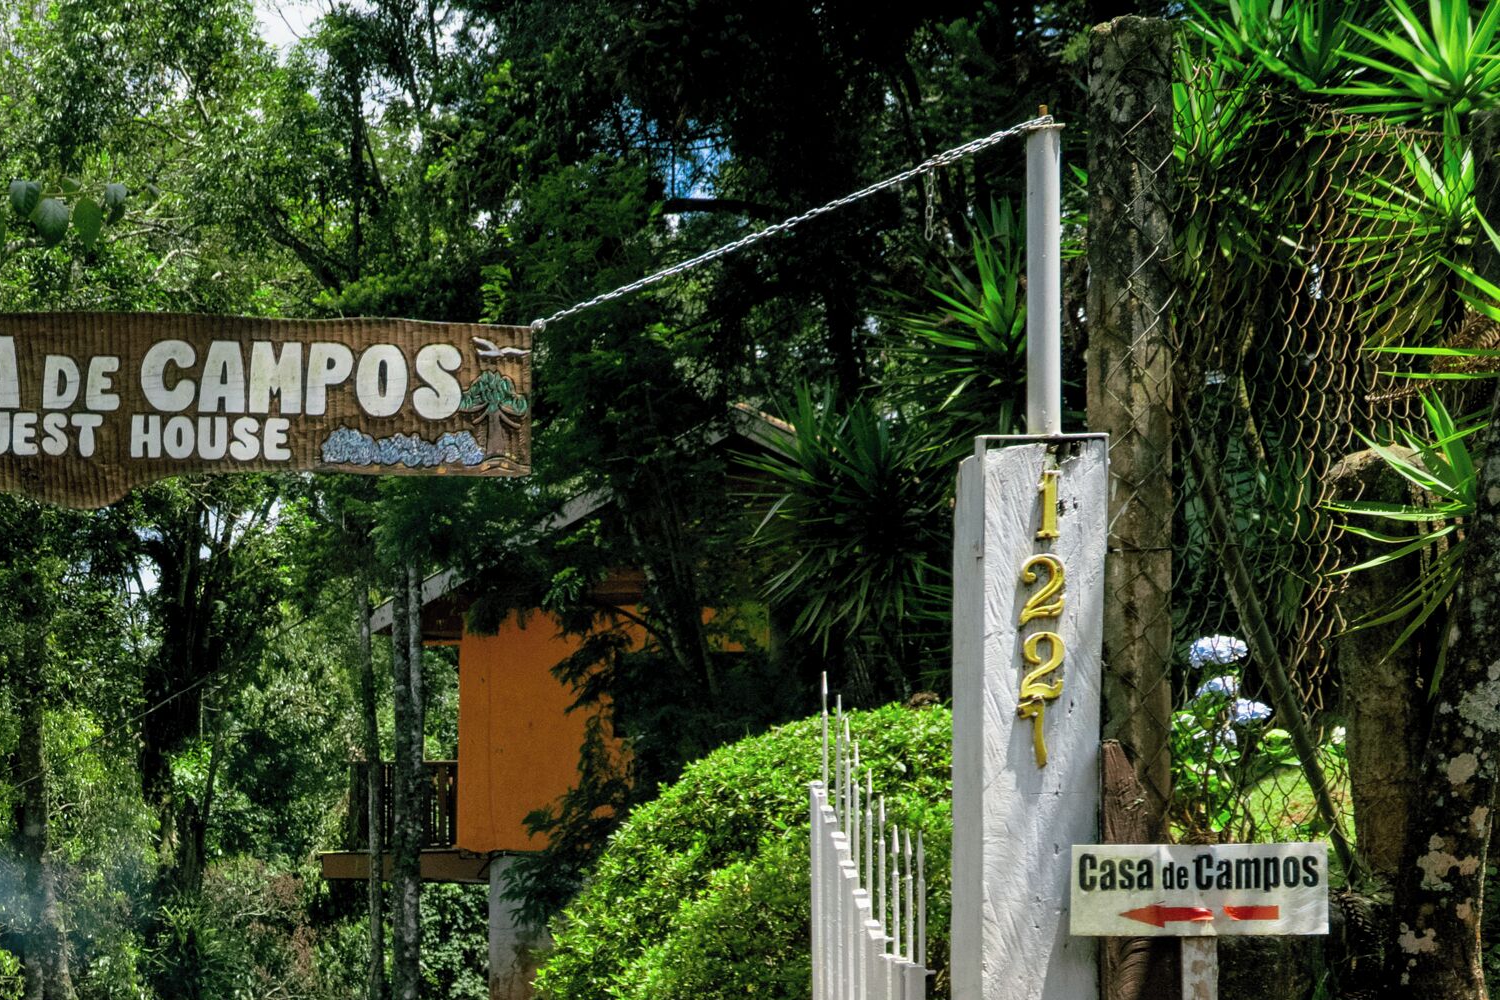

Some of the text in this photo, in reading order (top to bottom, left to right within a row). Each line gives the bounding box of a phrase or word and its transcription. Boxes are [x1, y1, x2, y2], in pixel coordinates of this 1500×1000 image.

[43, 354, 120, 412] DE
[139, 338, 464, 421] CAMPOS
[130, 414, 292, 462] HOUSE
[1078, 853, 1320, 892] Casa de Campos
